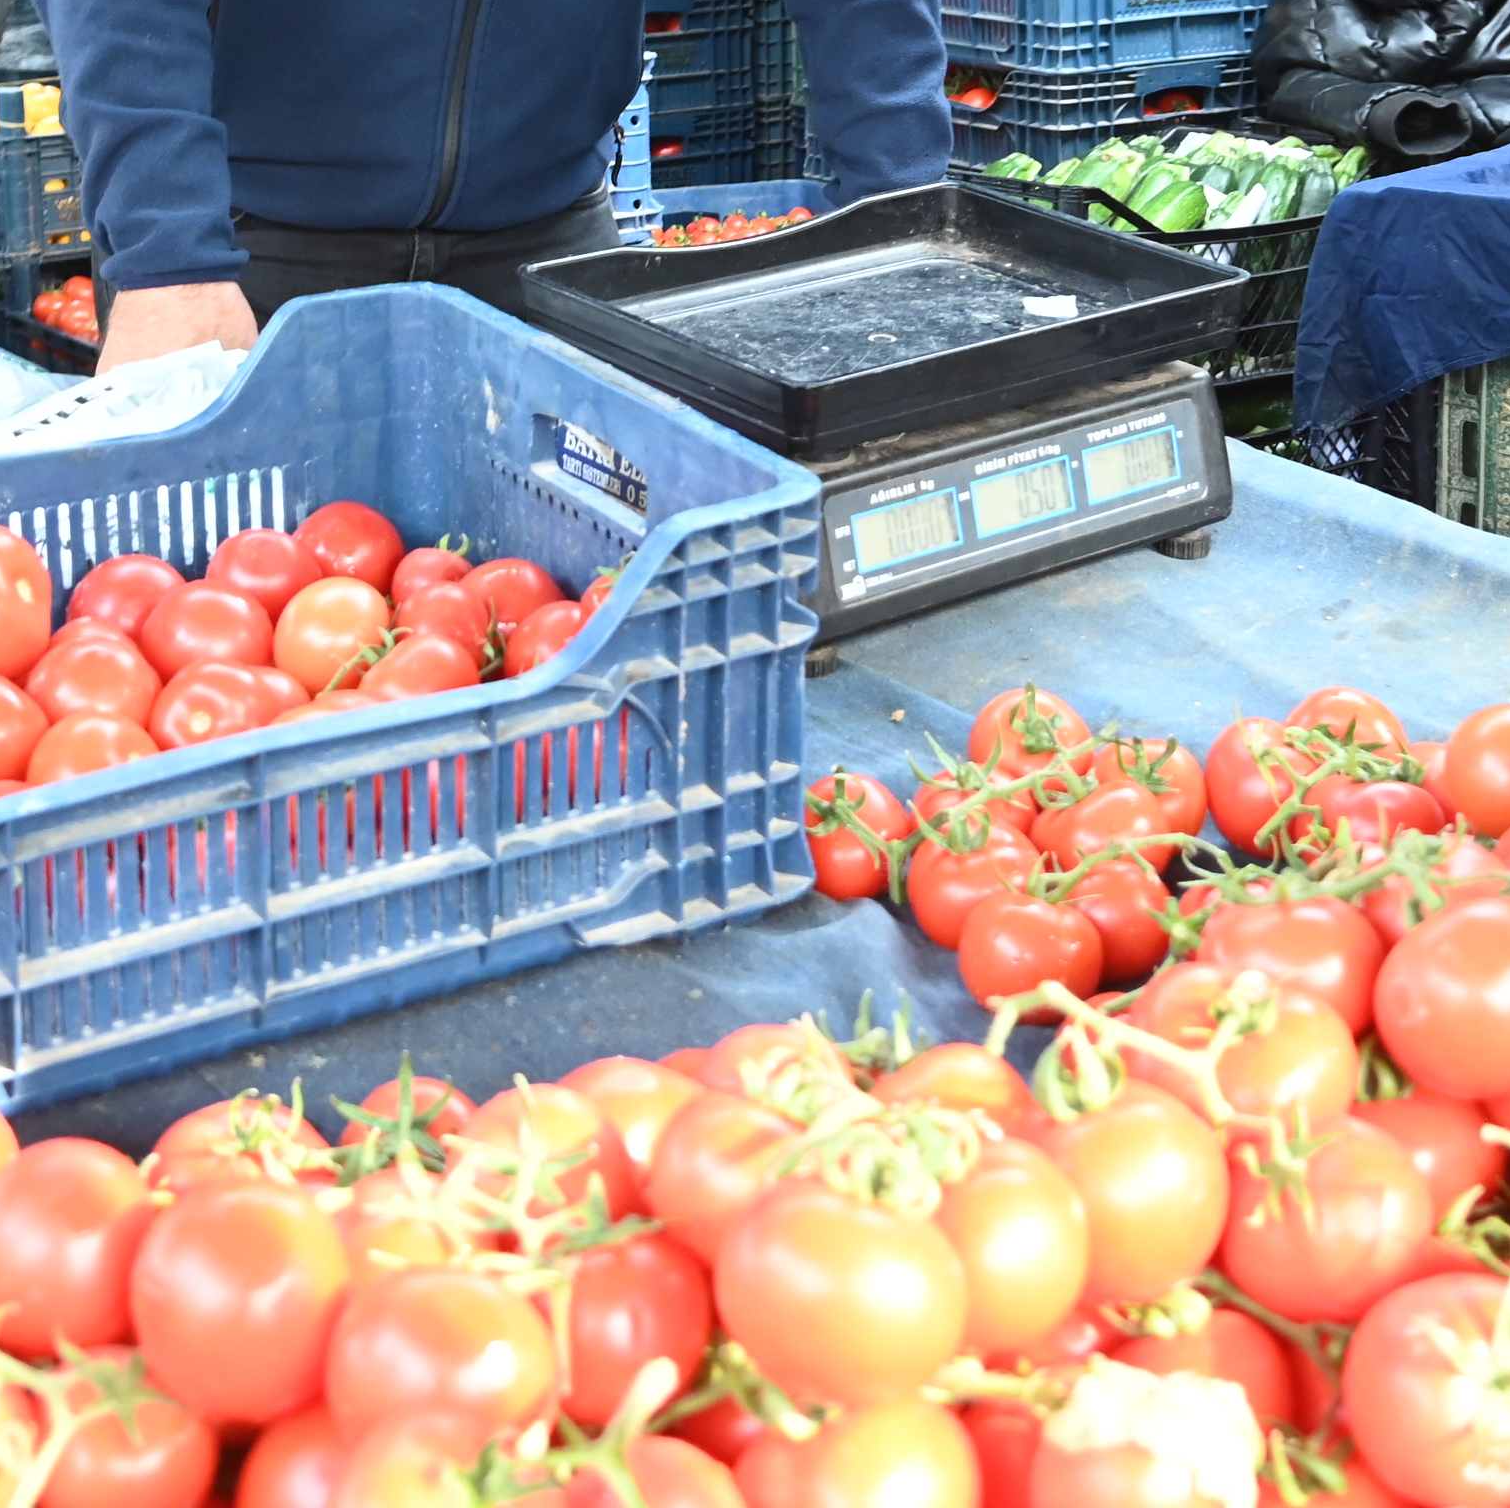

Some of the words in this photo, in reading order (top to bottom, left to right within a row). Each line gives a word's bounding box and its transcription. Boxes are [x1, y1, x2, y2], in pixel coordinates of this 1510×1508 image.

[1086, 423, 1128, 443] TOPLAM
[562, 453, 583, 477] TARTI
[1007, 448, 1038, 466] FİYAT
[870, 482, 916, 505] AĞIRLIK
[920, 480, 935, 491] kg
